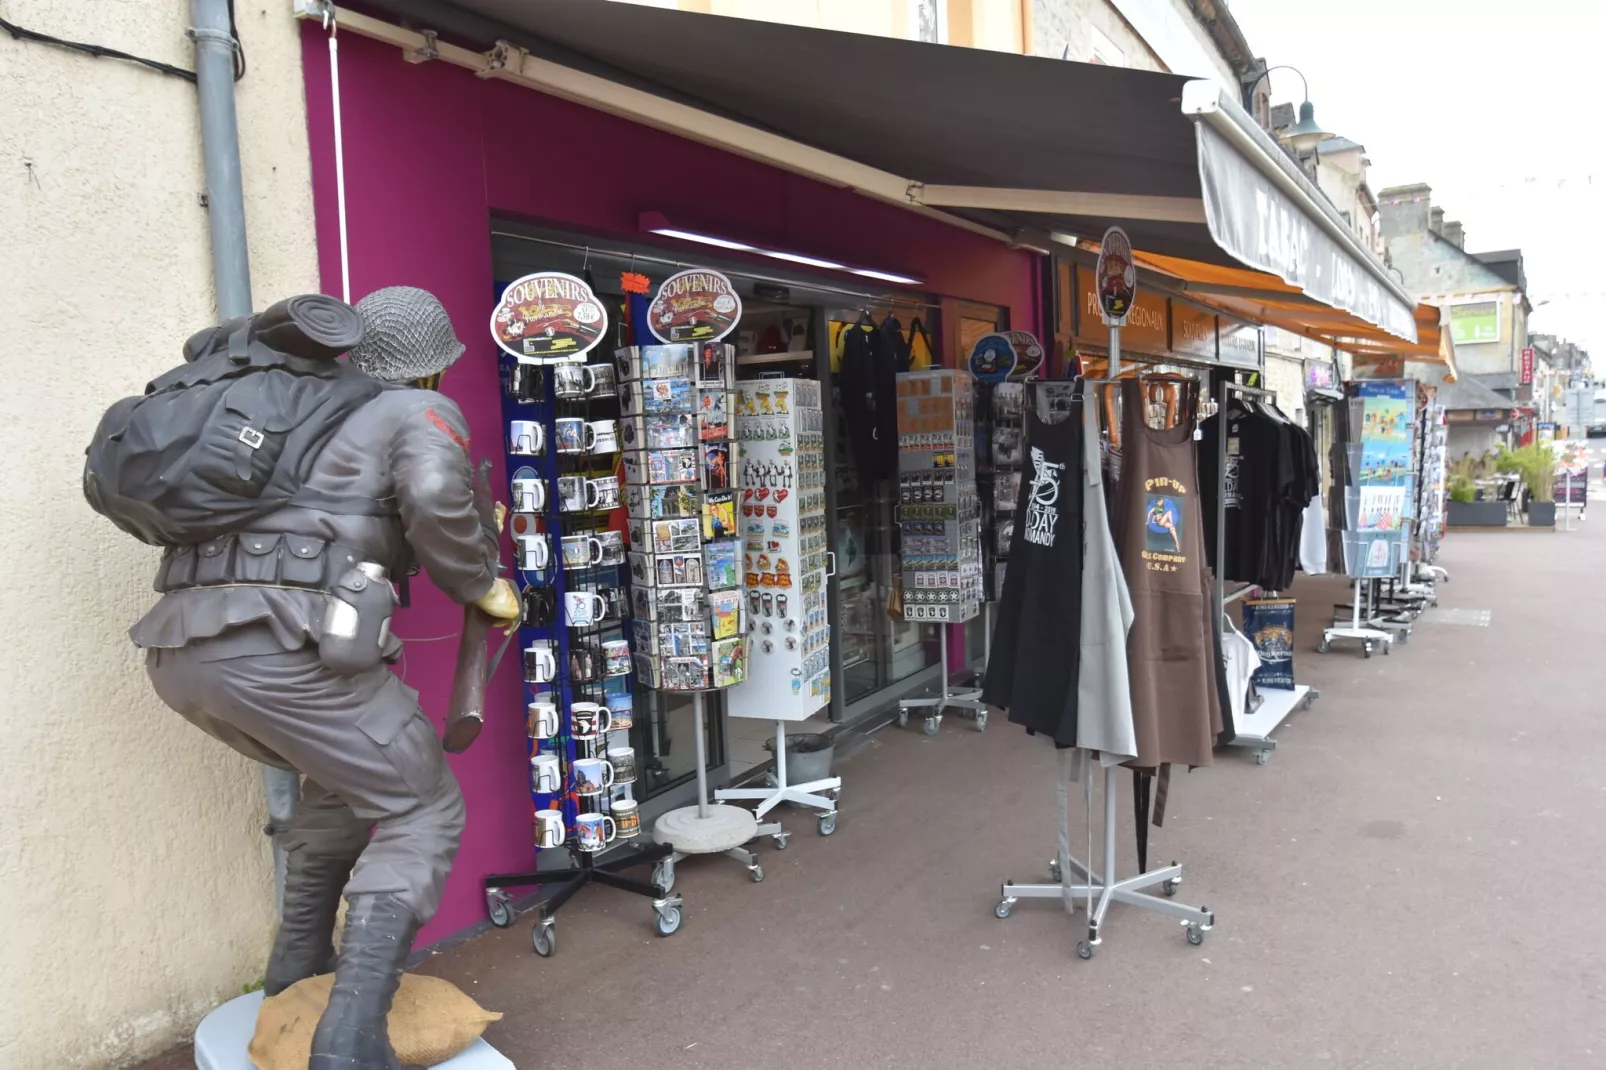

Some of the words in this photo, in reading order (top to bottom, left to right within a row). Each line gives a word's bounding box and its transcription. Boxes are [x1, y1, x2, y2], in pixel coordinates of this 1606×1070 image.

[1256, 187, 1308, 276] TABAC
[506, 278, 588, 308] SOUVENIRS
[661, 273, 727, 301] SOUVENIRS
